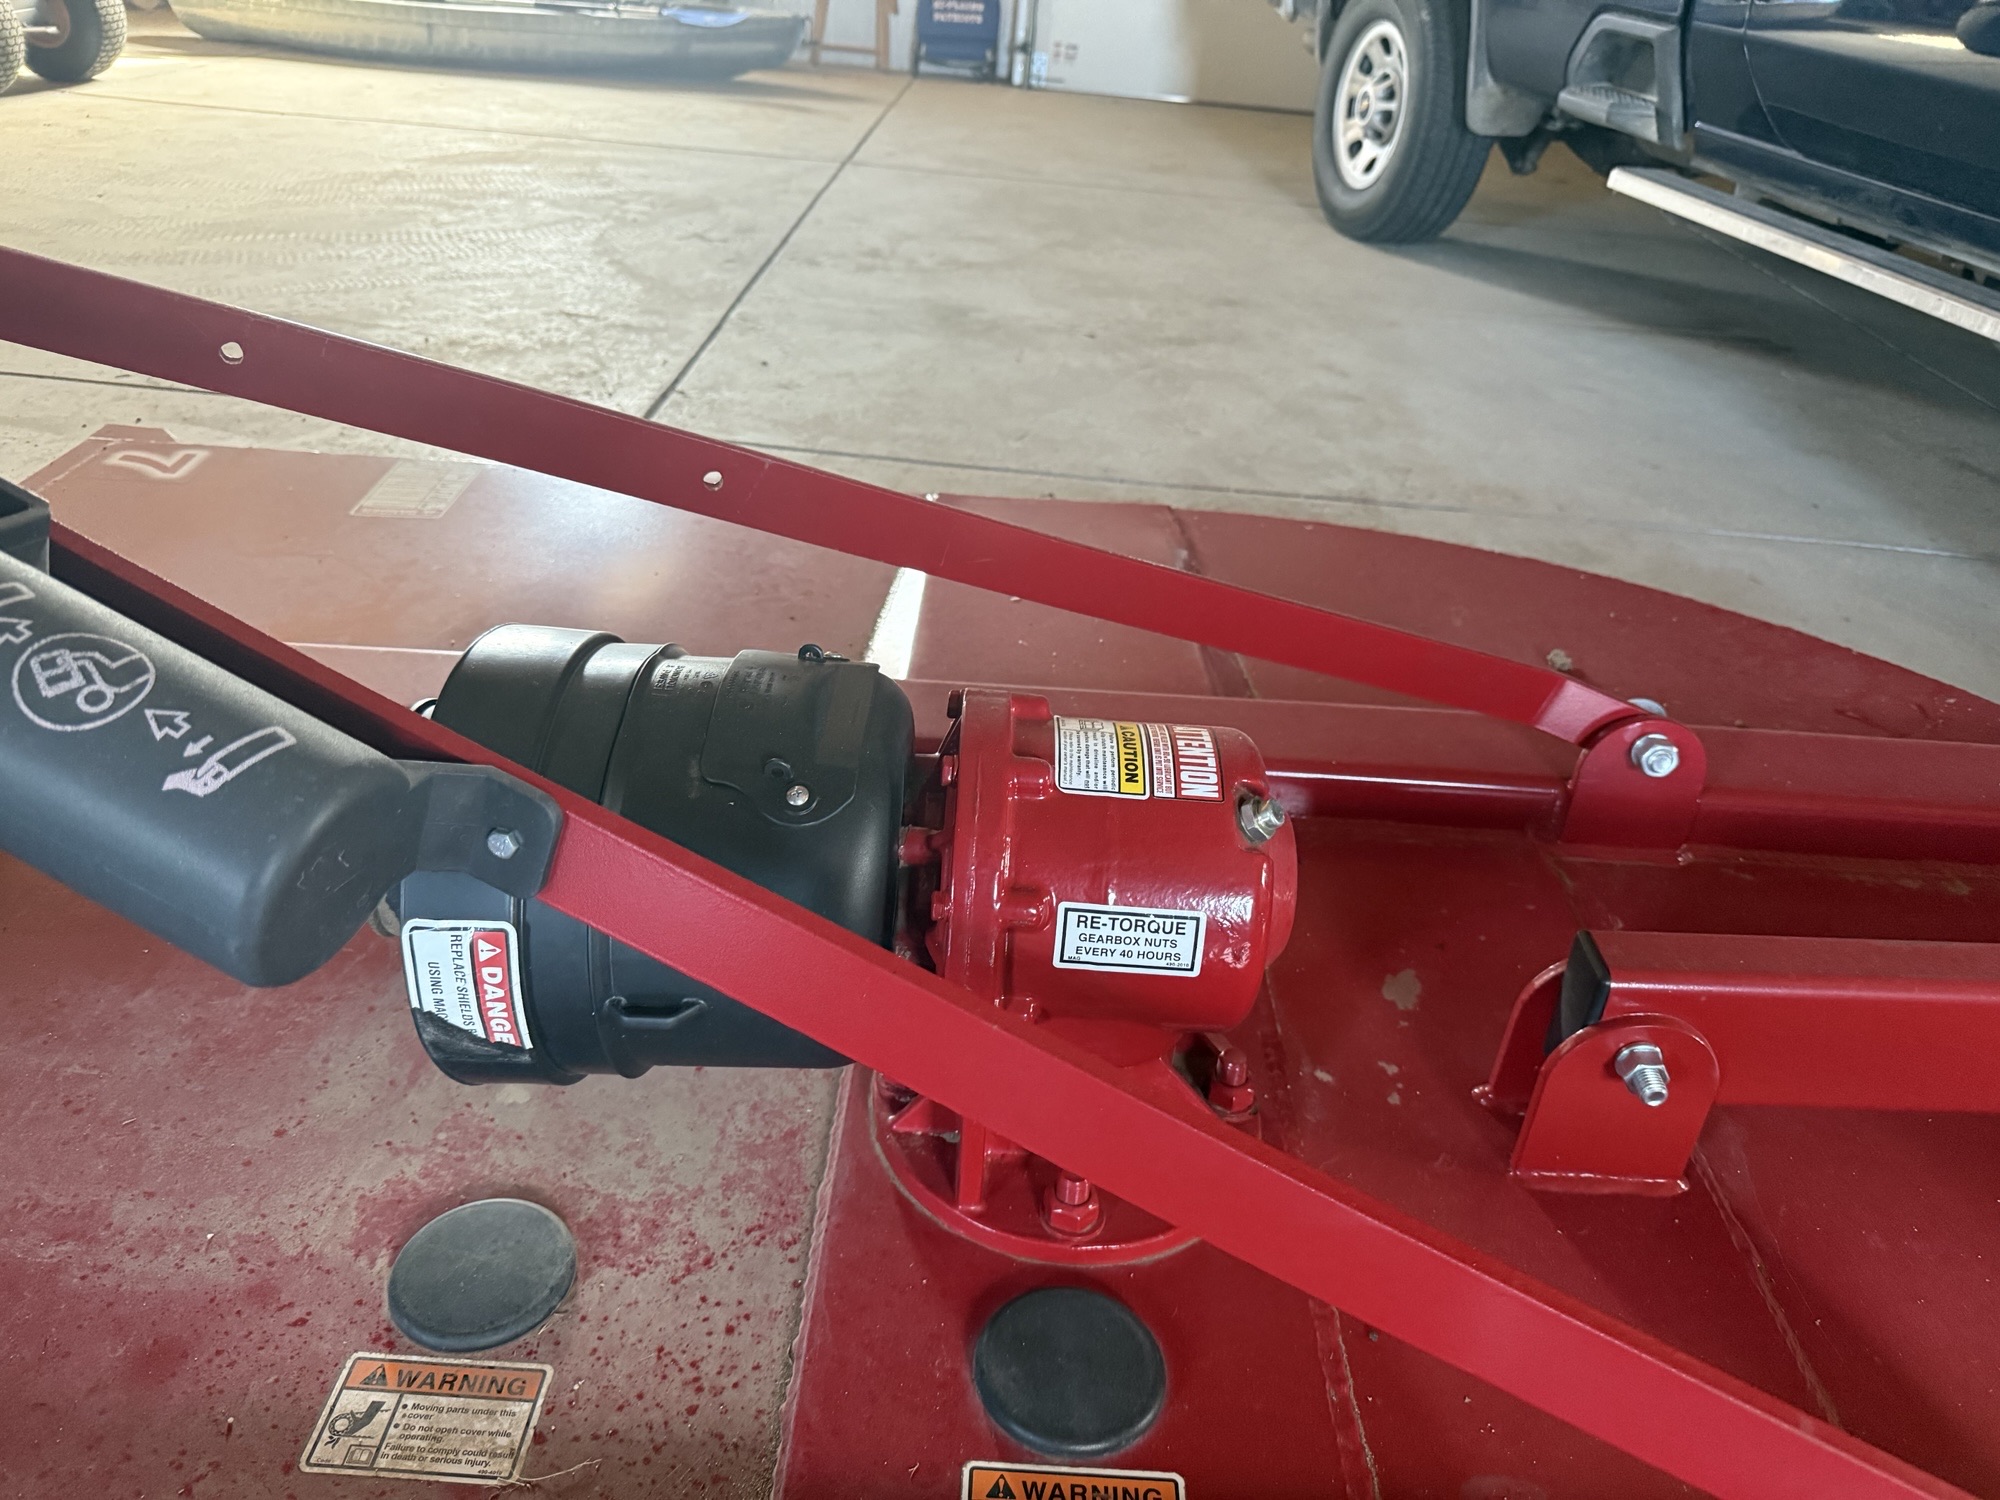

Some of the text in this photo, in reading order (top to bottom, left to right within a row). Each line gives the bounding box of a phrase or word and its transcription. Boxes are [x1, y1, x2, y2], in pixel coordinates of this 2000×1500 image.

[1121, 731, 1139, 783] CAUTION
[1172, 726, 1219, 798] ATTENTION
[1077, 915, 1186, 935] RE-TORQUE
[1079, 933, 1178, 948] GEARBOX NUTS
[450, 935, 466, 984] REPLACE
[1076, 946, 1181, 961] EVERY 40 HOURS
[428, 961, 443, 995] USING
[456, 983, 475, 1027] SHIELDS
[397, 1369, 527, 1395] WARNING
[411, 1403, 444, 1413] Moving
[446, 1407, 469, 1415] parts
[472, 1408, 498, 1416] under
[399, 1433, 444, 1443] operating.
[403, 1423, 415, 1431] Do
[488, 1430, 512, 1438] while
[384, 1443, 415, 1451] Failure
[417, 1445, 426, 1453] to
[428, 1447, 461, 1457] comply
[462, 1448, 488, 1457] could
[391, 1453, 416, 1461] death
[429, 1456, 462, 1464] serious
[464, 1459, 491, 1467] injury.
[1021, 1480, 1163, 1500] WARNING
